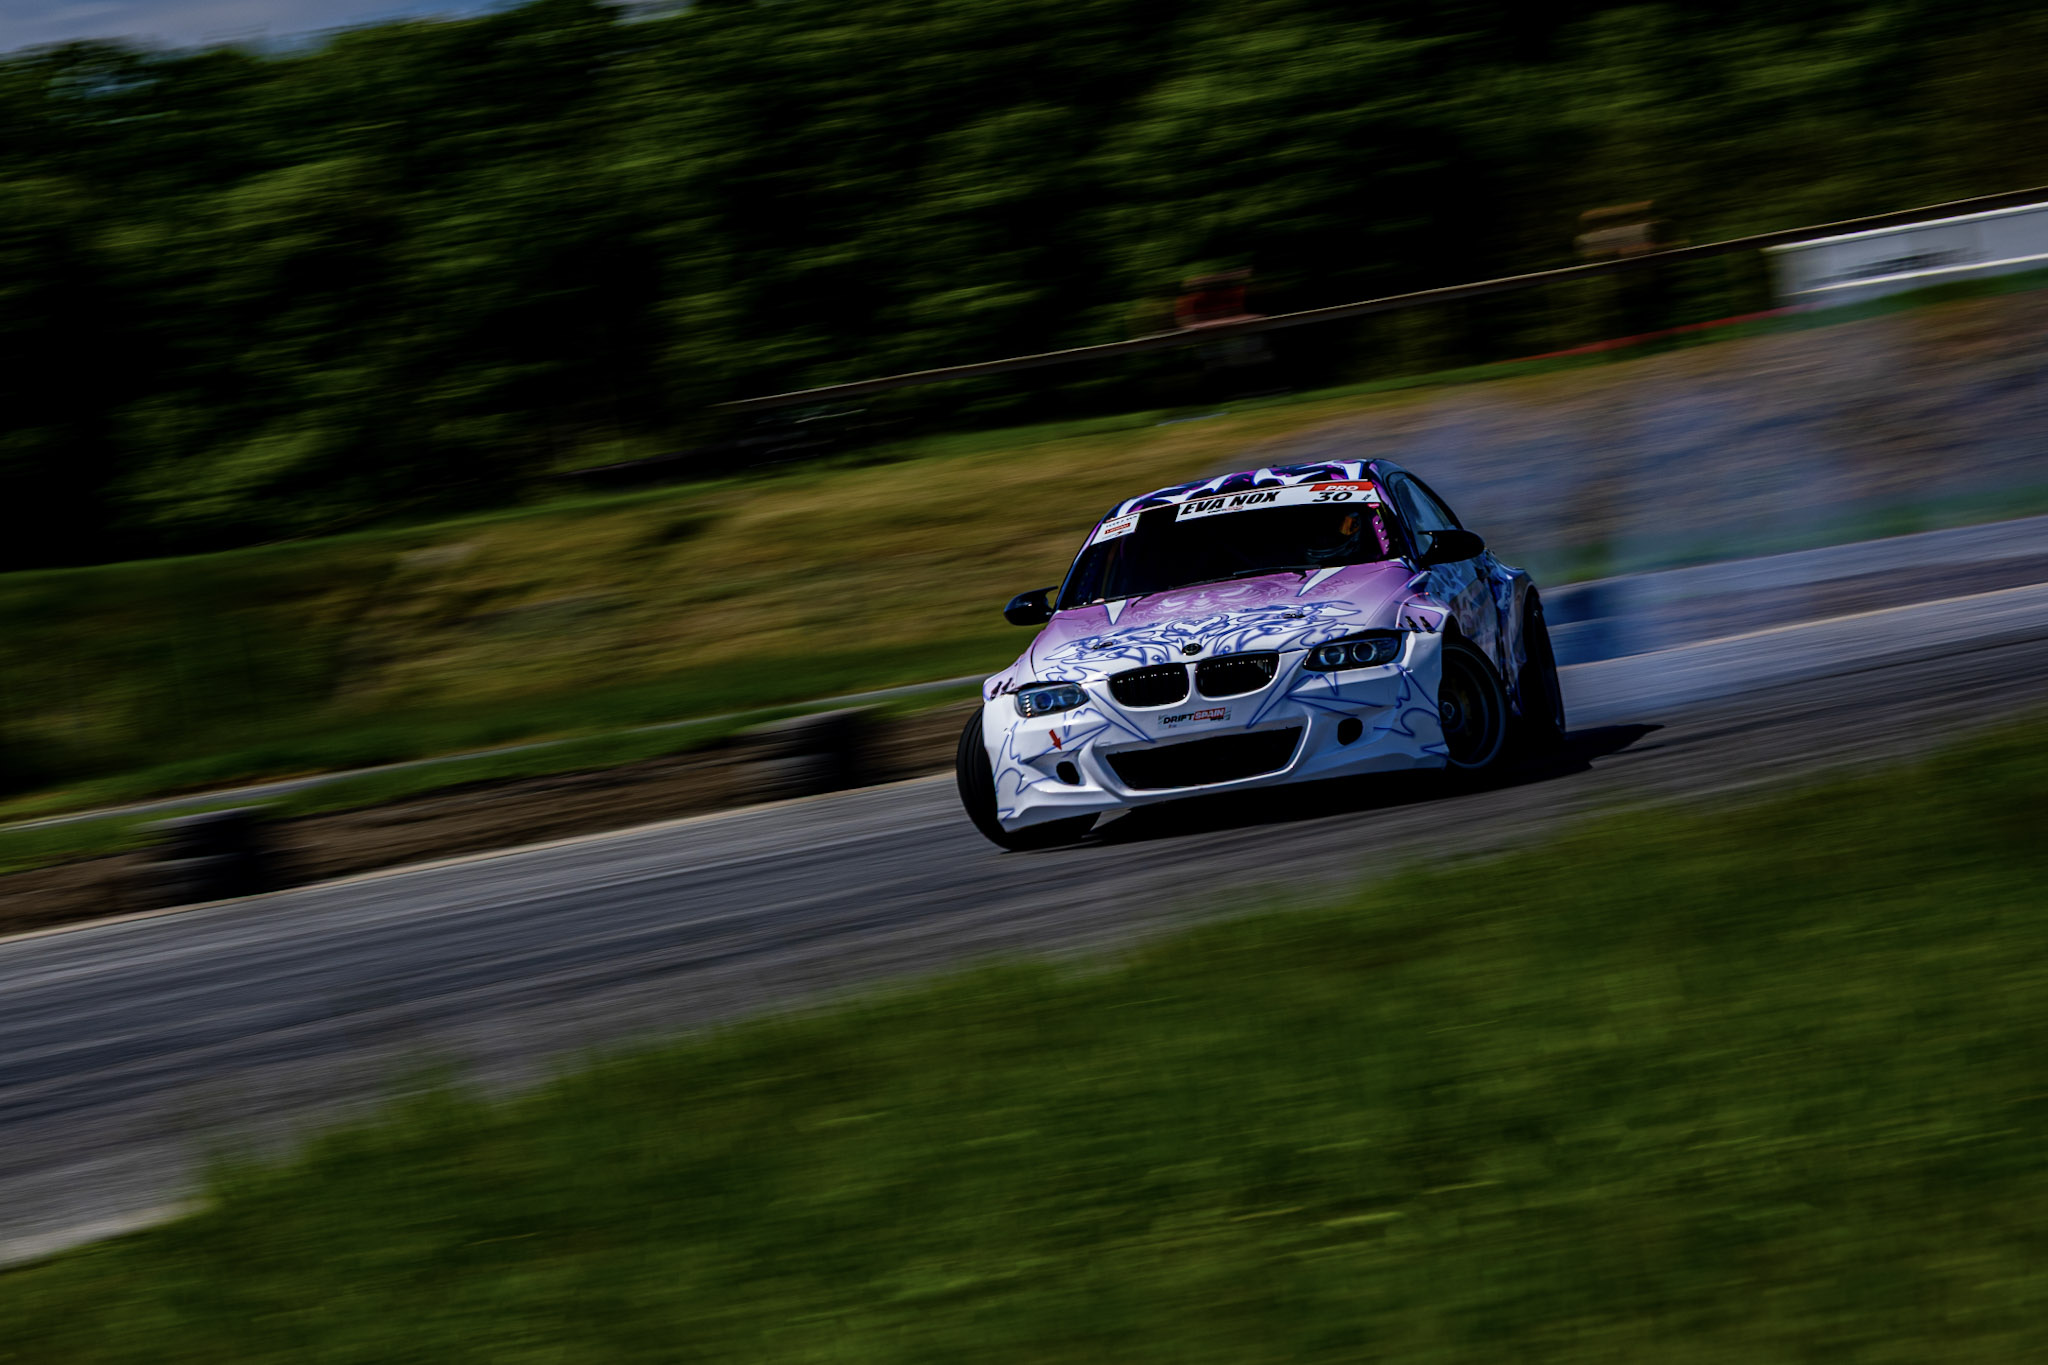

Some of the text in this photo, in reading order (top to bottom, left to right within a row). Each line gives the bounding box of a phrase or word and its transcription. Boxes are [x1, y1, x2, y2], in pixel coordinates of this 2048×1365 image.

[1180, 498, 1222, 515] EVA
[1229, 491, 1280, 507] NOX
[1312, 492, 1353, 502] 30
